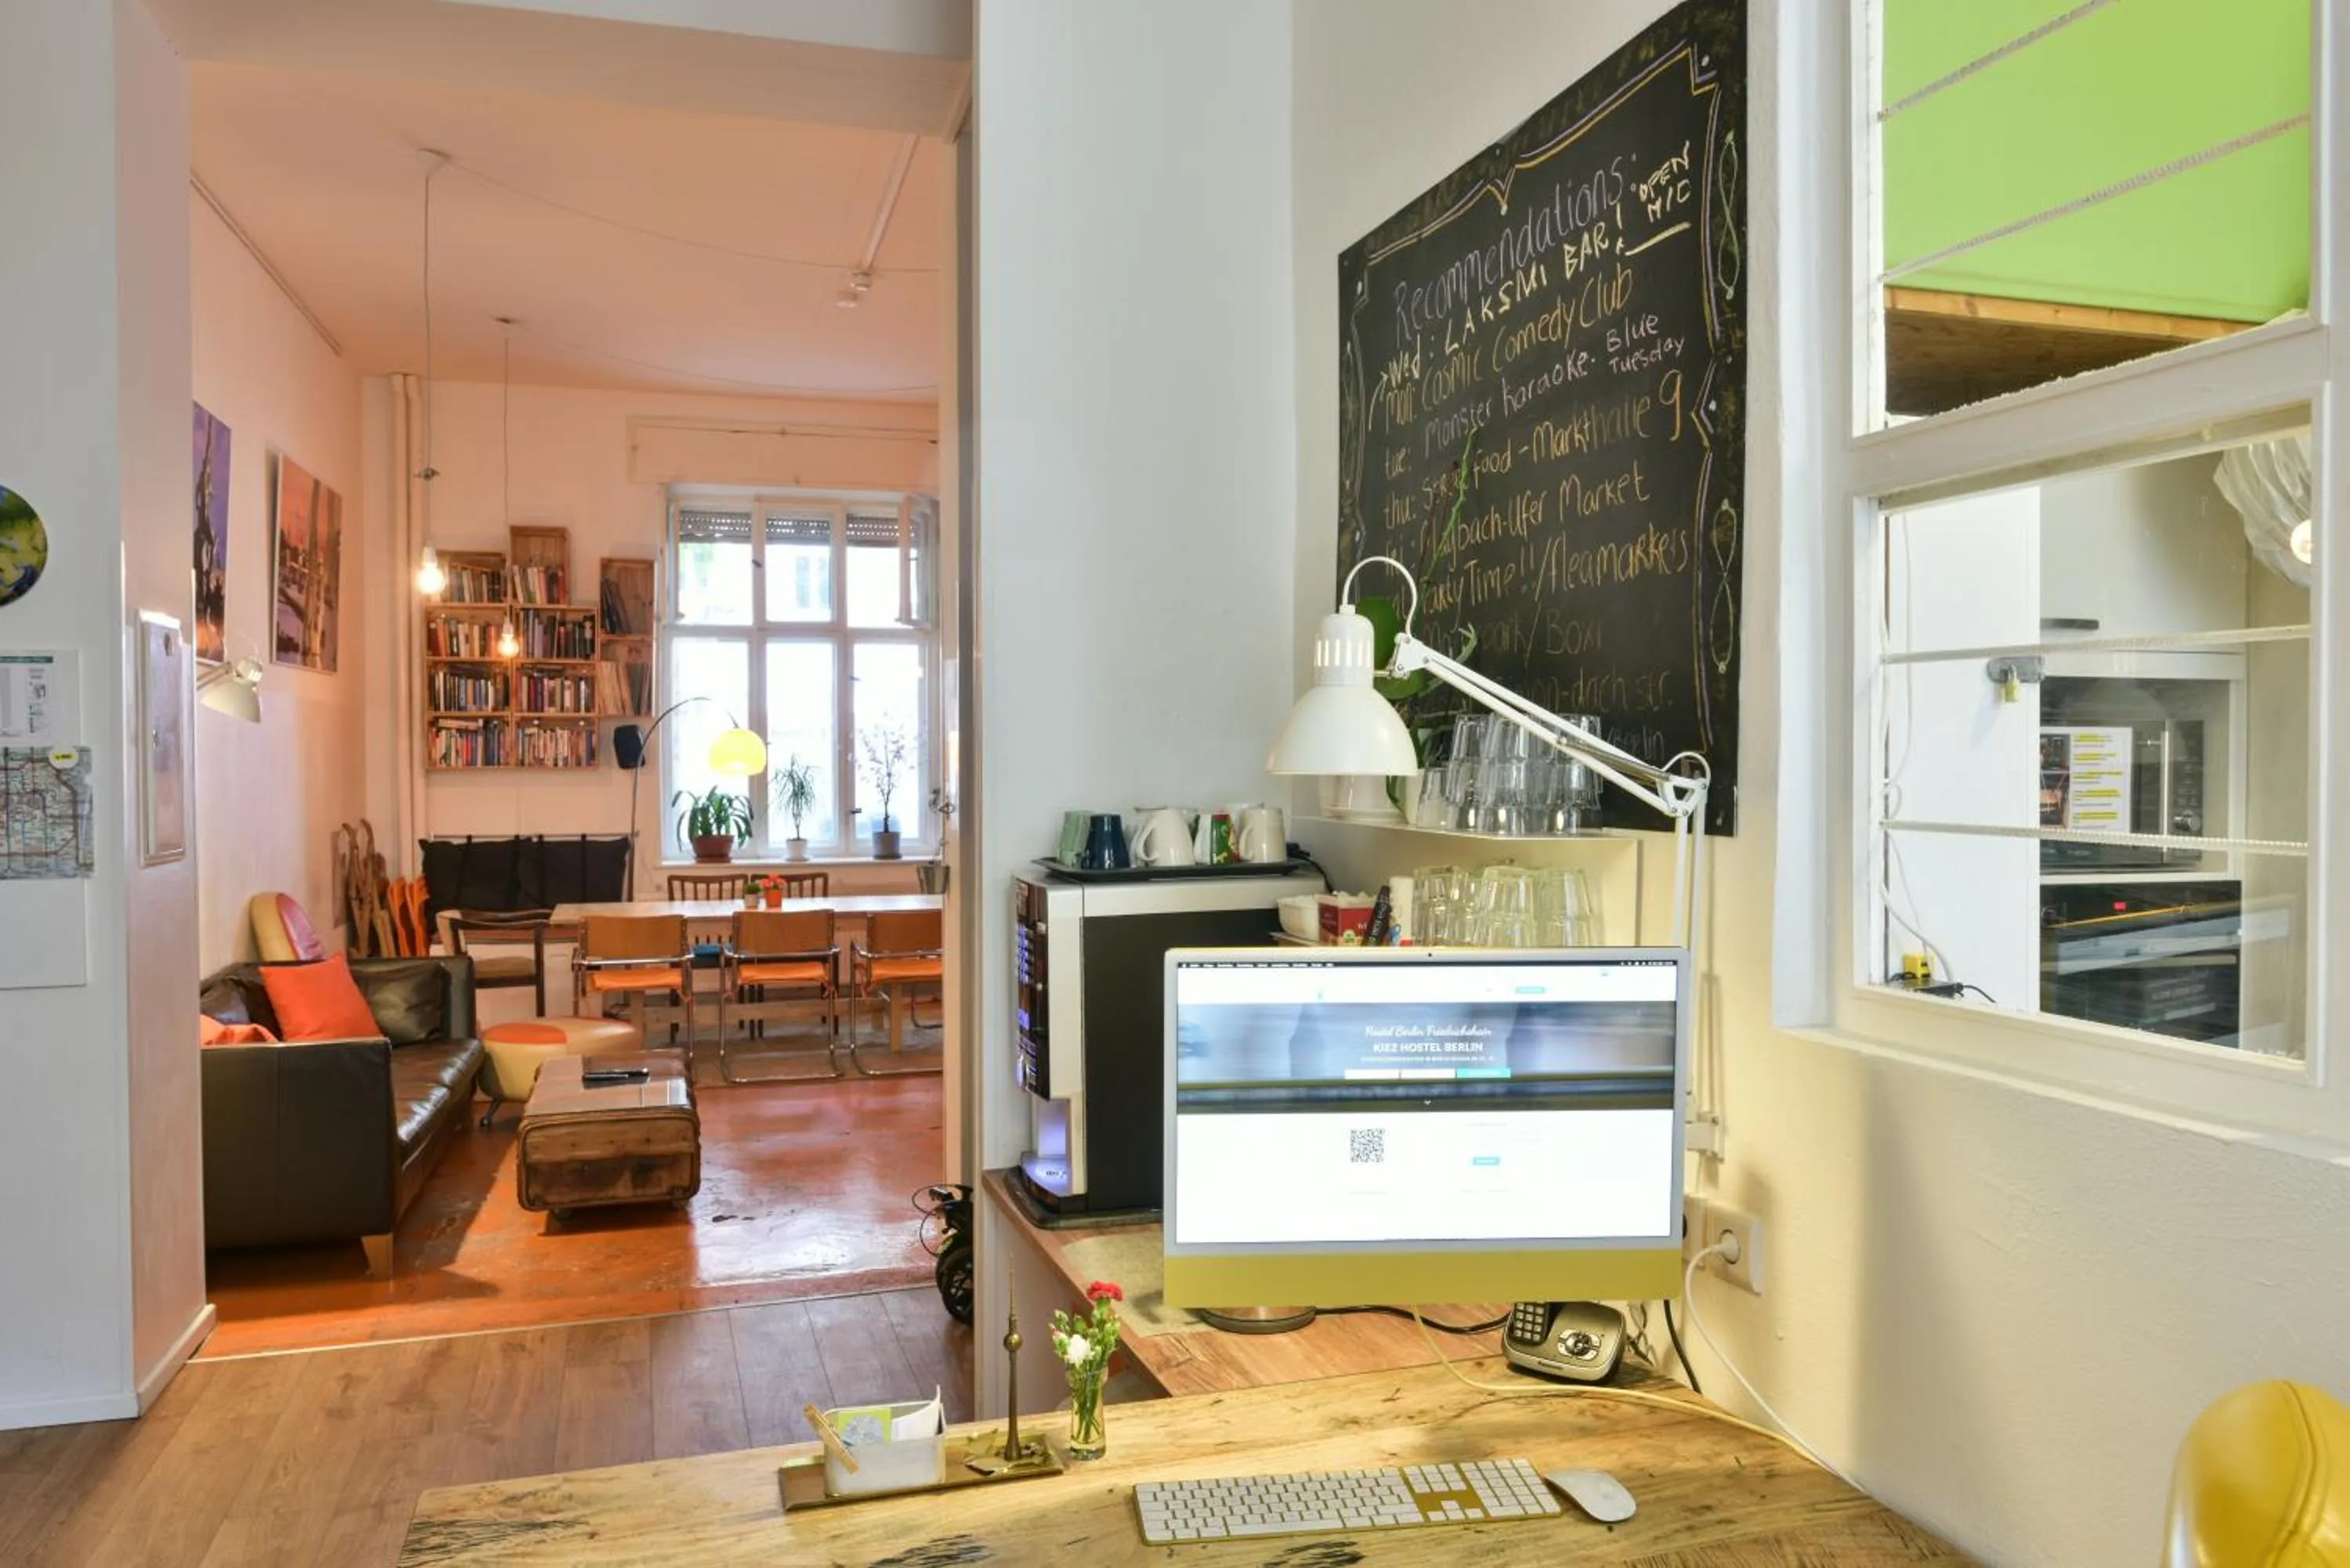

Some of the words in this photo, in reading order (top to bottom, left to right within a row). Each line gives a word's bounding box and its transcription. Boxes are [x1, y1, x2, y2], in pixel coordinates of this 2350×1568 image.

[1578, 262, 1635, 329] Club
[1606, 312, 1660, 353] Blue
[1400, 1042, 1442, 1053] HOSTEL
[1444, 1042, 1484, 1053] BERLIN
